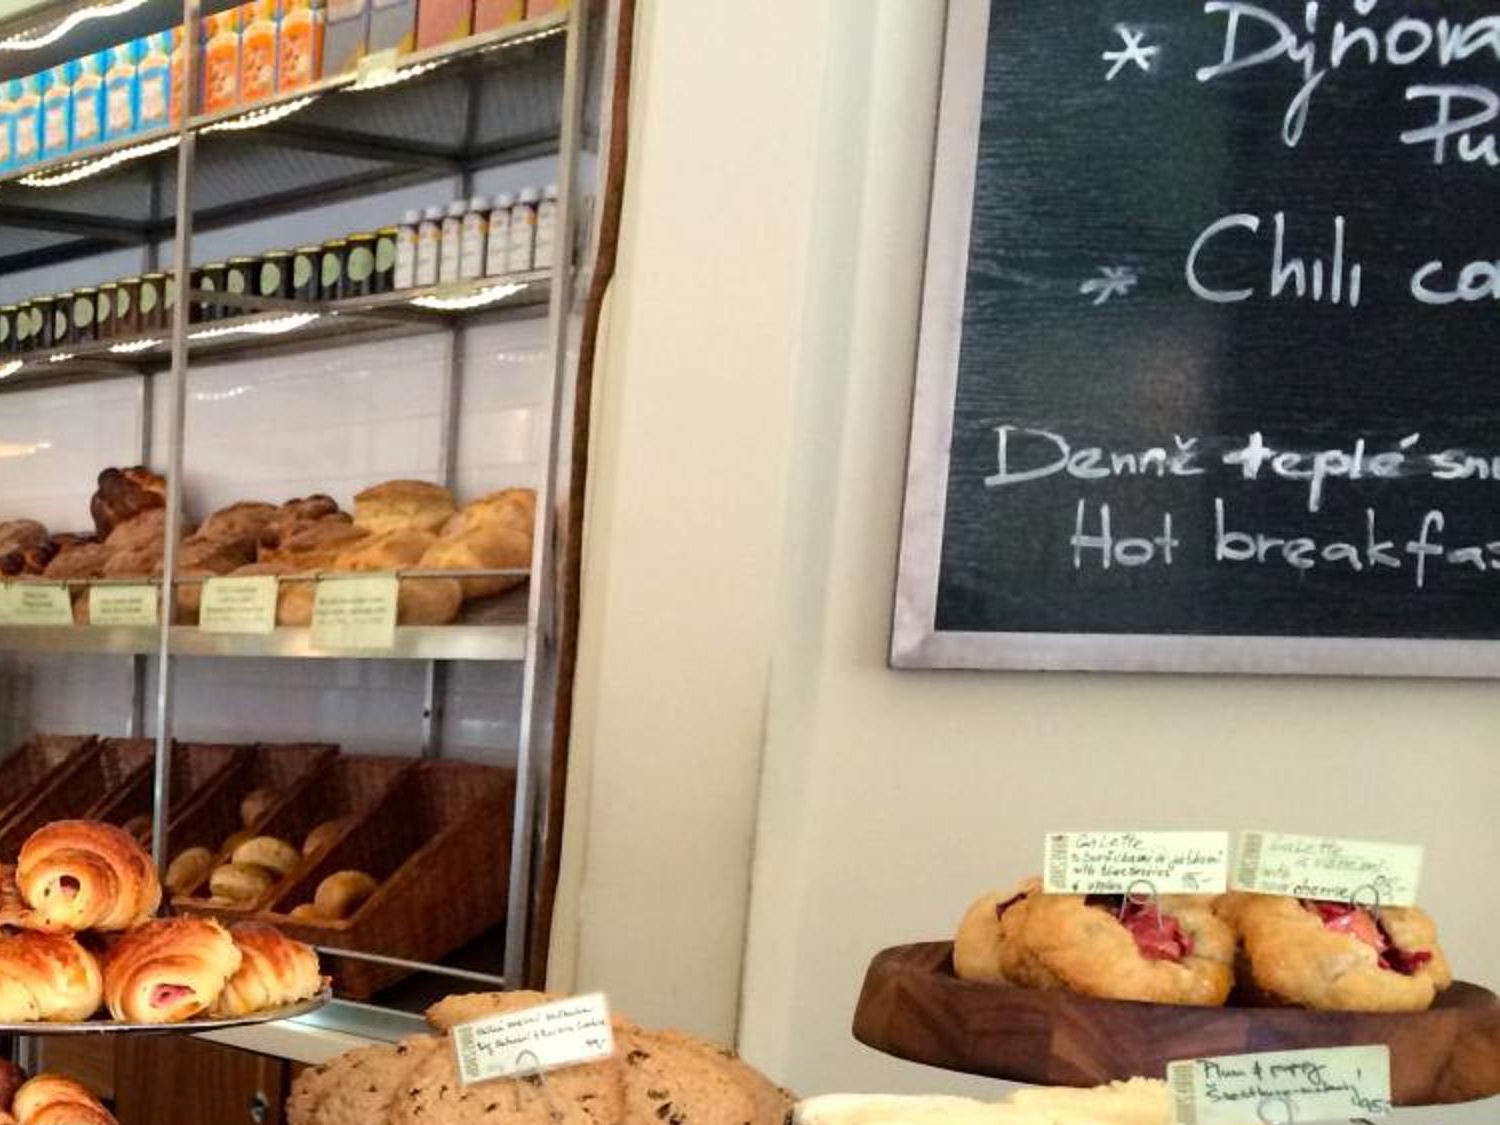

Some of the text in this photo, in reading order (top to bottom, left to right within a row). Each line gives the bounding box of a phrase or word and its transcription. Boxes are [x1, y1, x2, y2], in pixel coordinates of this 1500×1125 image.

[1187, 212, 1362, 306] Chili
[984, 425, 1205, 487] Denně
[1070, 497, 1179, 570] Hot
